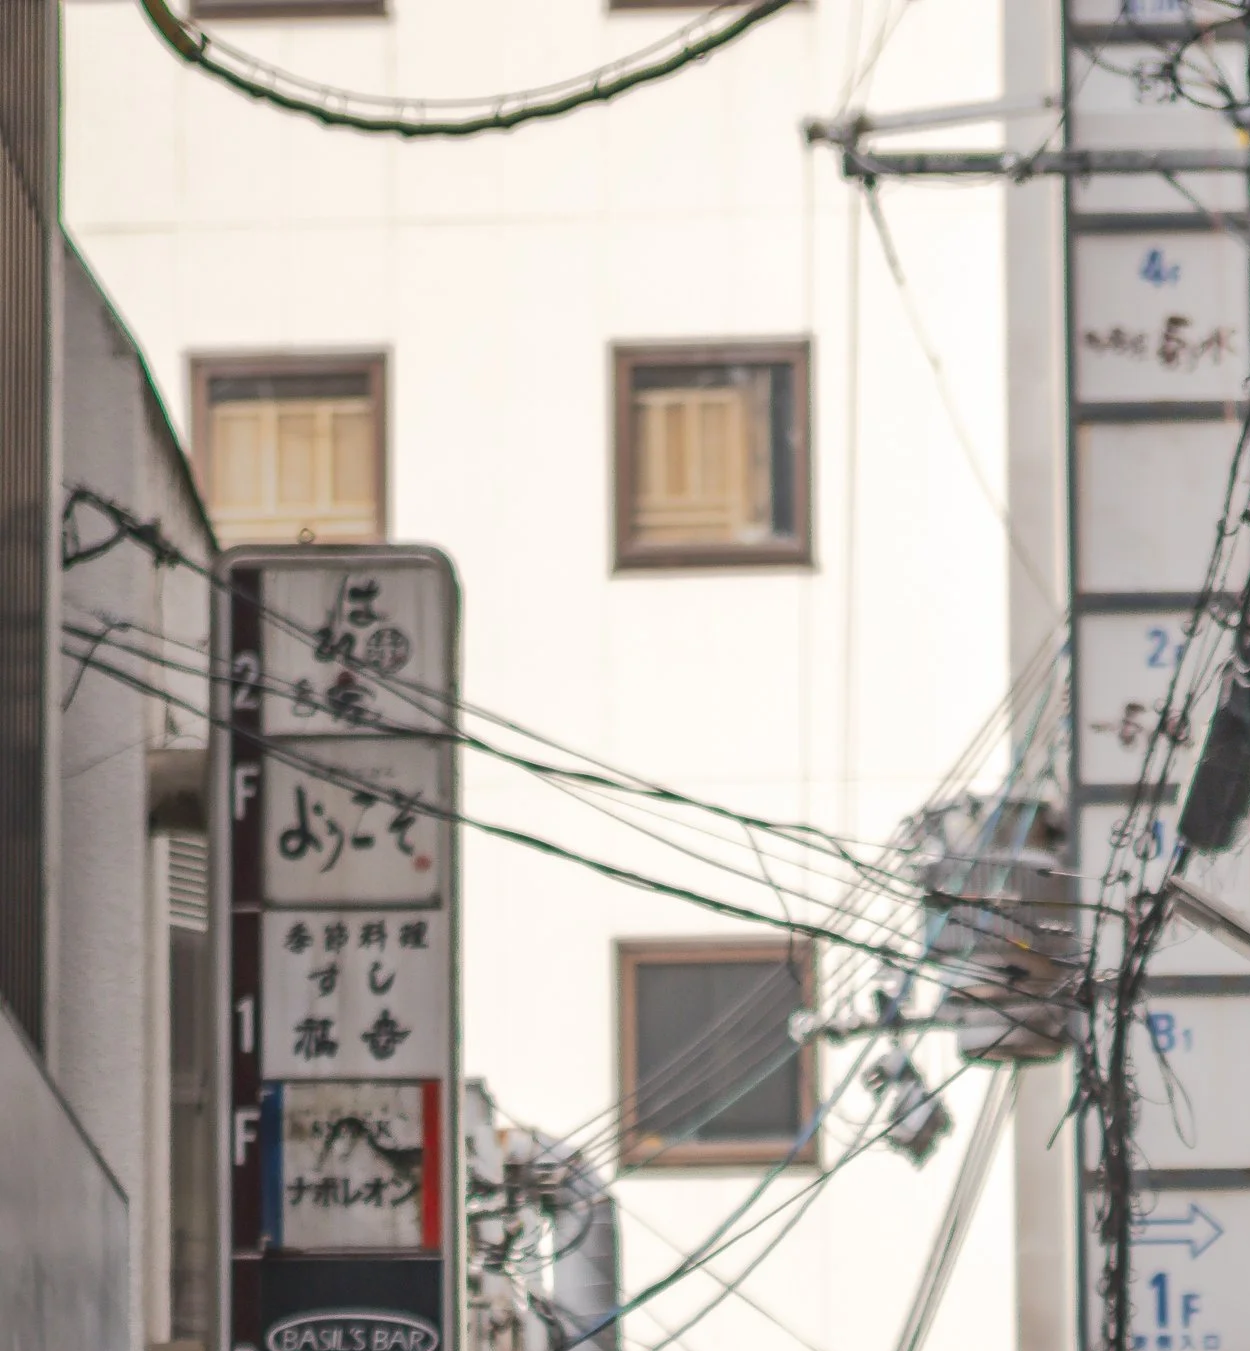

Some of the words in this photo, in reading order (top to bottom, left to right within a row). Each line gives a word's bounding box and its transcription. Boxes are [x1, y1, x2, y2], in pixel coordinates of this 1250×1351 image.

[279, 782, 423, 873] ようこそ
[308, 960, 396, 998] すし
[282, 1327, 366, 1351] BASIL'S
[371, 1328, 427, 1351] BAR
